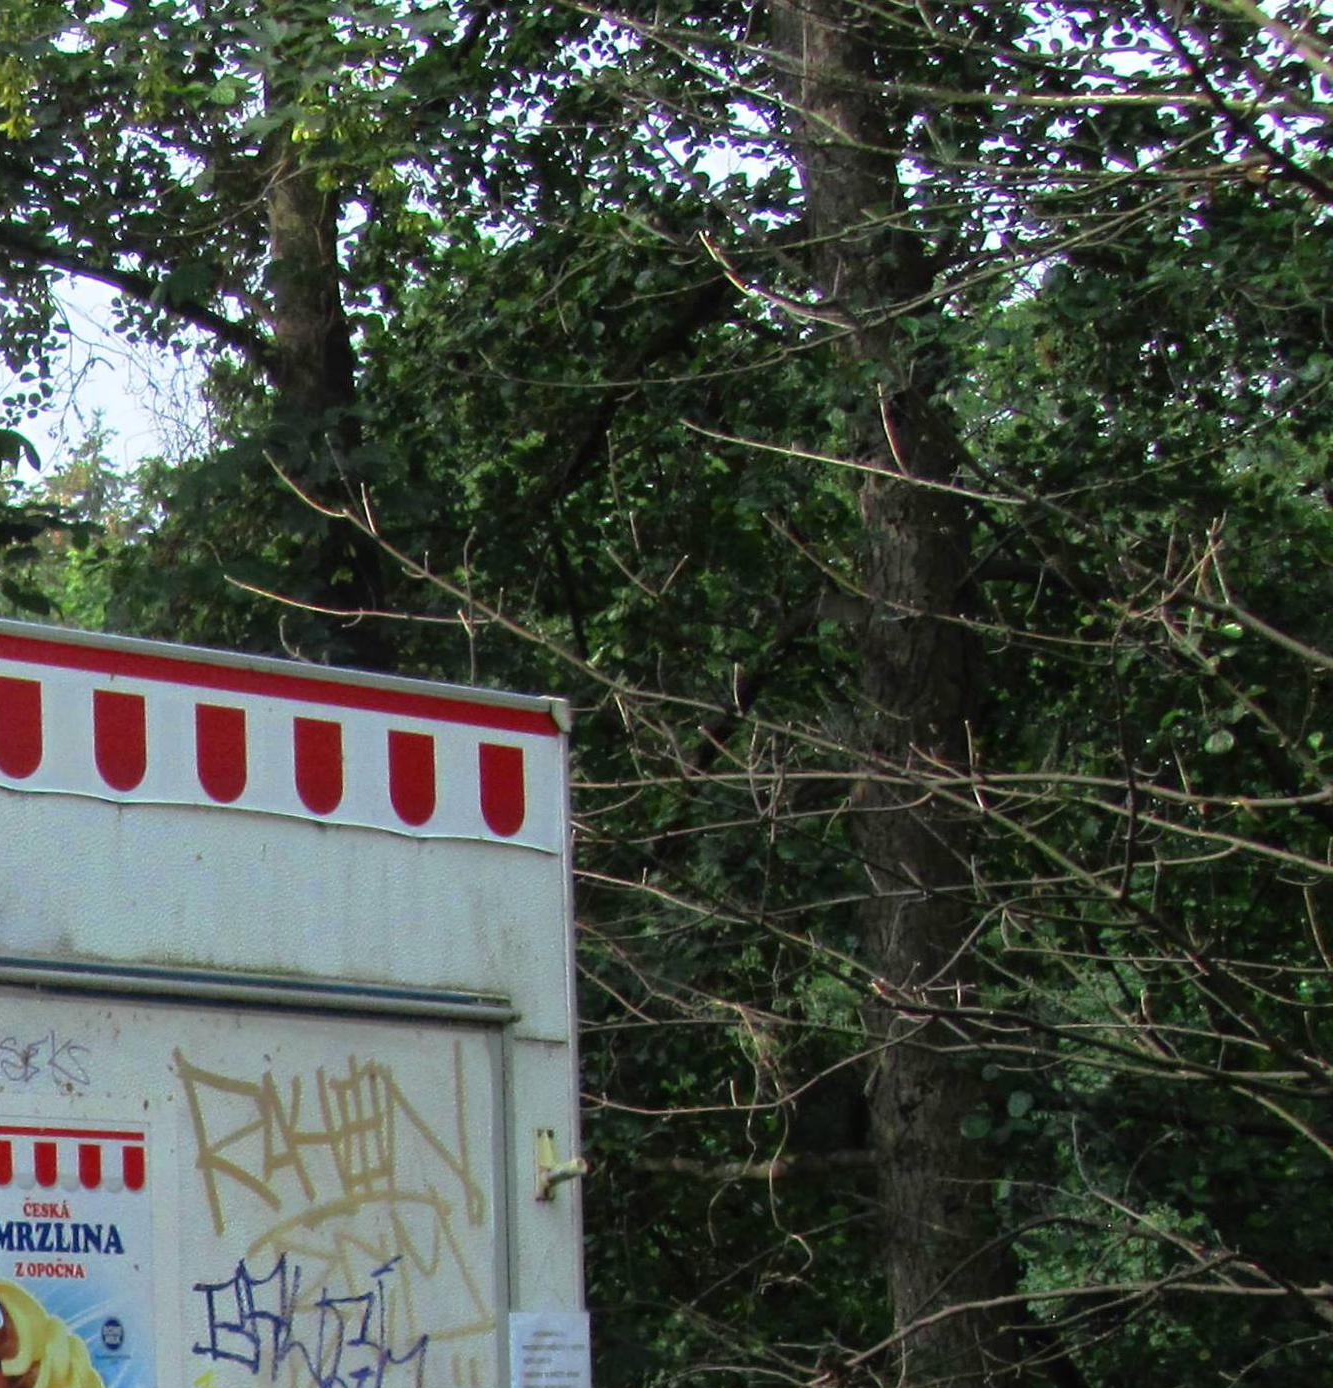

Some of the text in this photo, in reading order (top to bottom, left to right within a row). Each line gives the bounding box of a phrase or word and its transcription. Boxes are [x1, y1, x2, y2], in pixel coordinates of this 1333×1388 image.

[23, 1197, 71, 1219] ČESKÁ
[15, 1258, 85, 1279] Z OPOČNA
